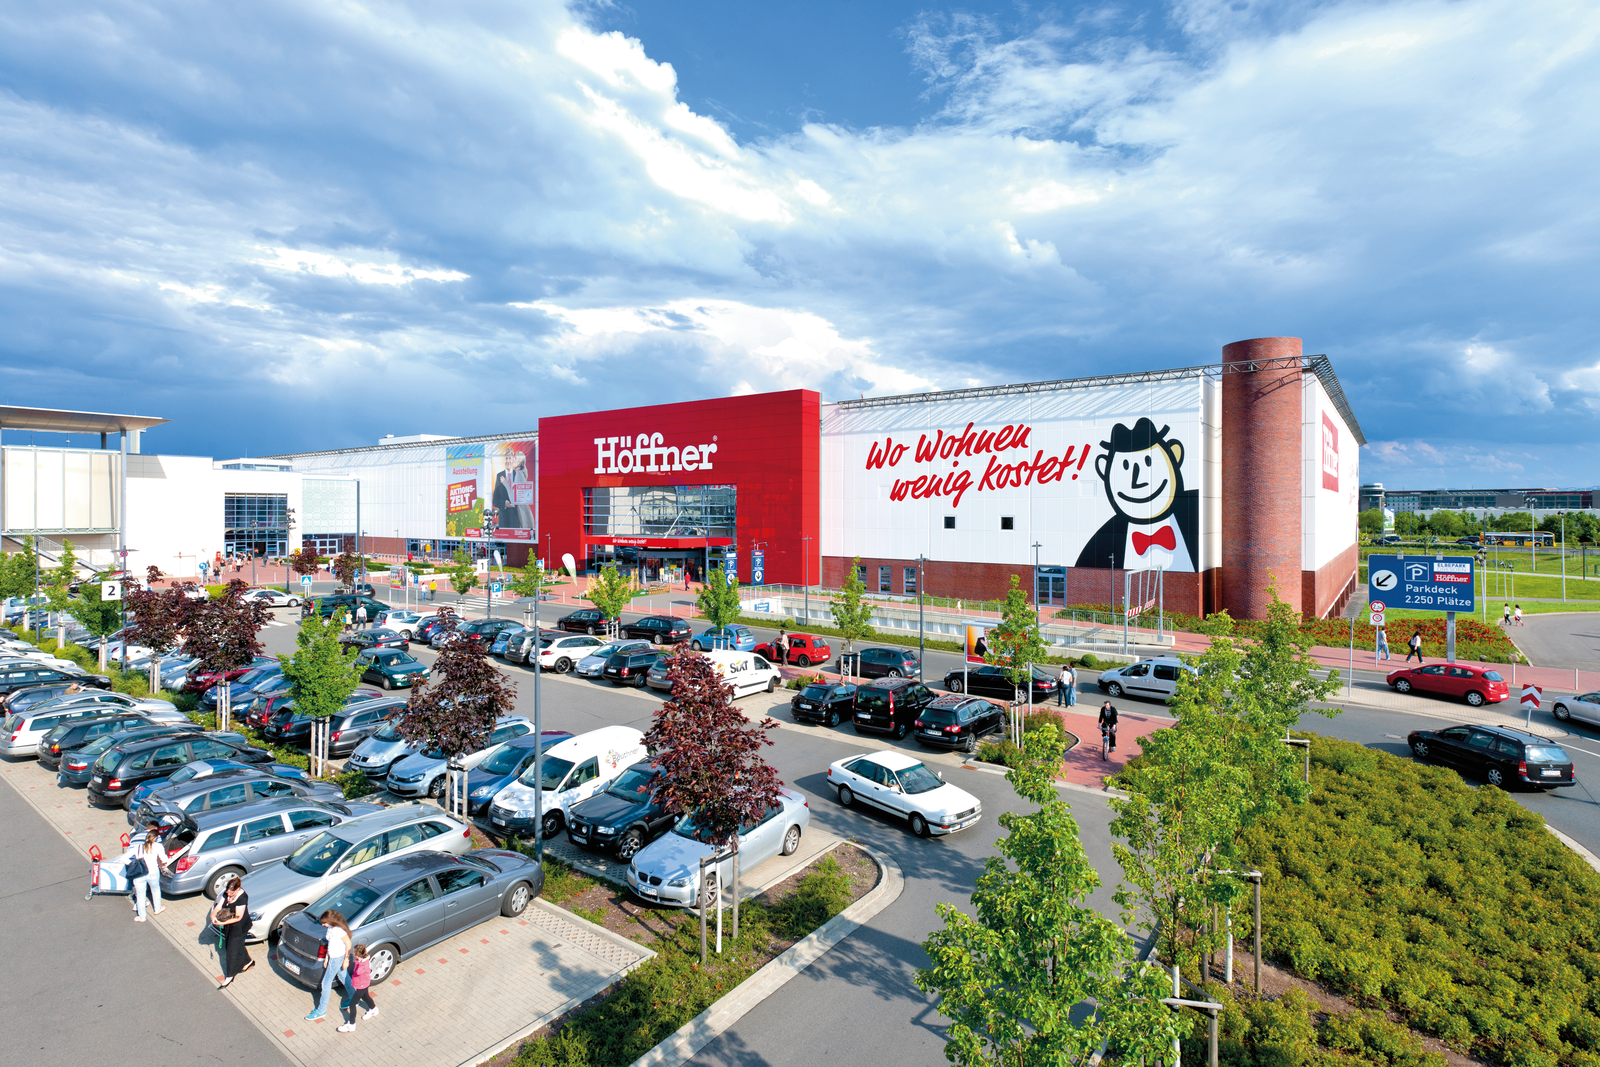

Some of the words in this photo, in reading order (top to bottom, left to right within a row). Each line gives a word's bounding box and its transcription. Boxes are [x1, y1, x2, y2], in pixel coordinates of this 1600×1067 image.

[865, 437, 910, 470] Wo
[914, 422, 1032, 463] Wohnen
[594, 432, 718, 474] Höffner
[452, 467, 478, 476] Ausstellung
[889, 460, 974, 508] wenig
[977, 443, 1091, 491] kostet!
[450, 485, 475, 496] AKTIONS-
[450, 493, 470, 507] ZELT
[1412, 568, 1423, 580] P
[1435, 574, 1468, 582] Höffner
[108, 585, 115, 596] 2
[1406, 584, 1458, 594] Parkdeck
[1405, 595, 1433, 604] 2.250
[1437, 596, 1471, 606] Plätze
